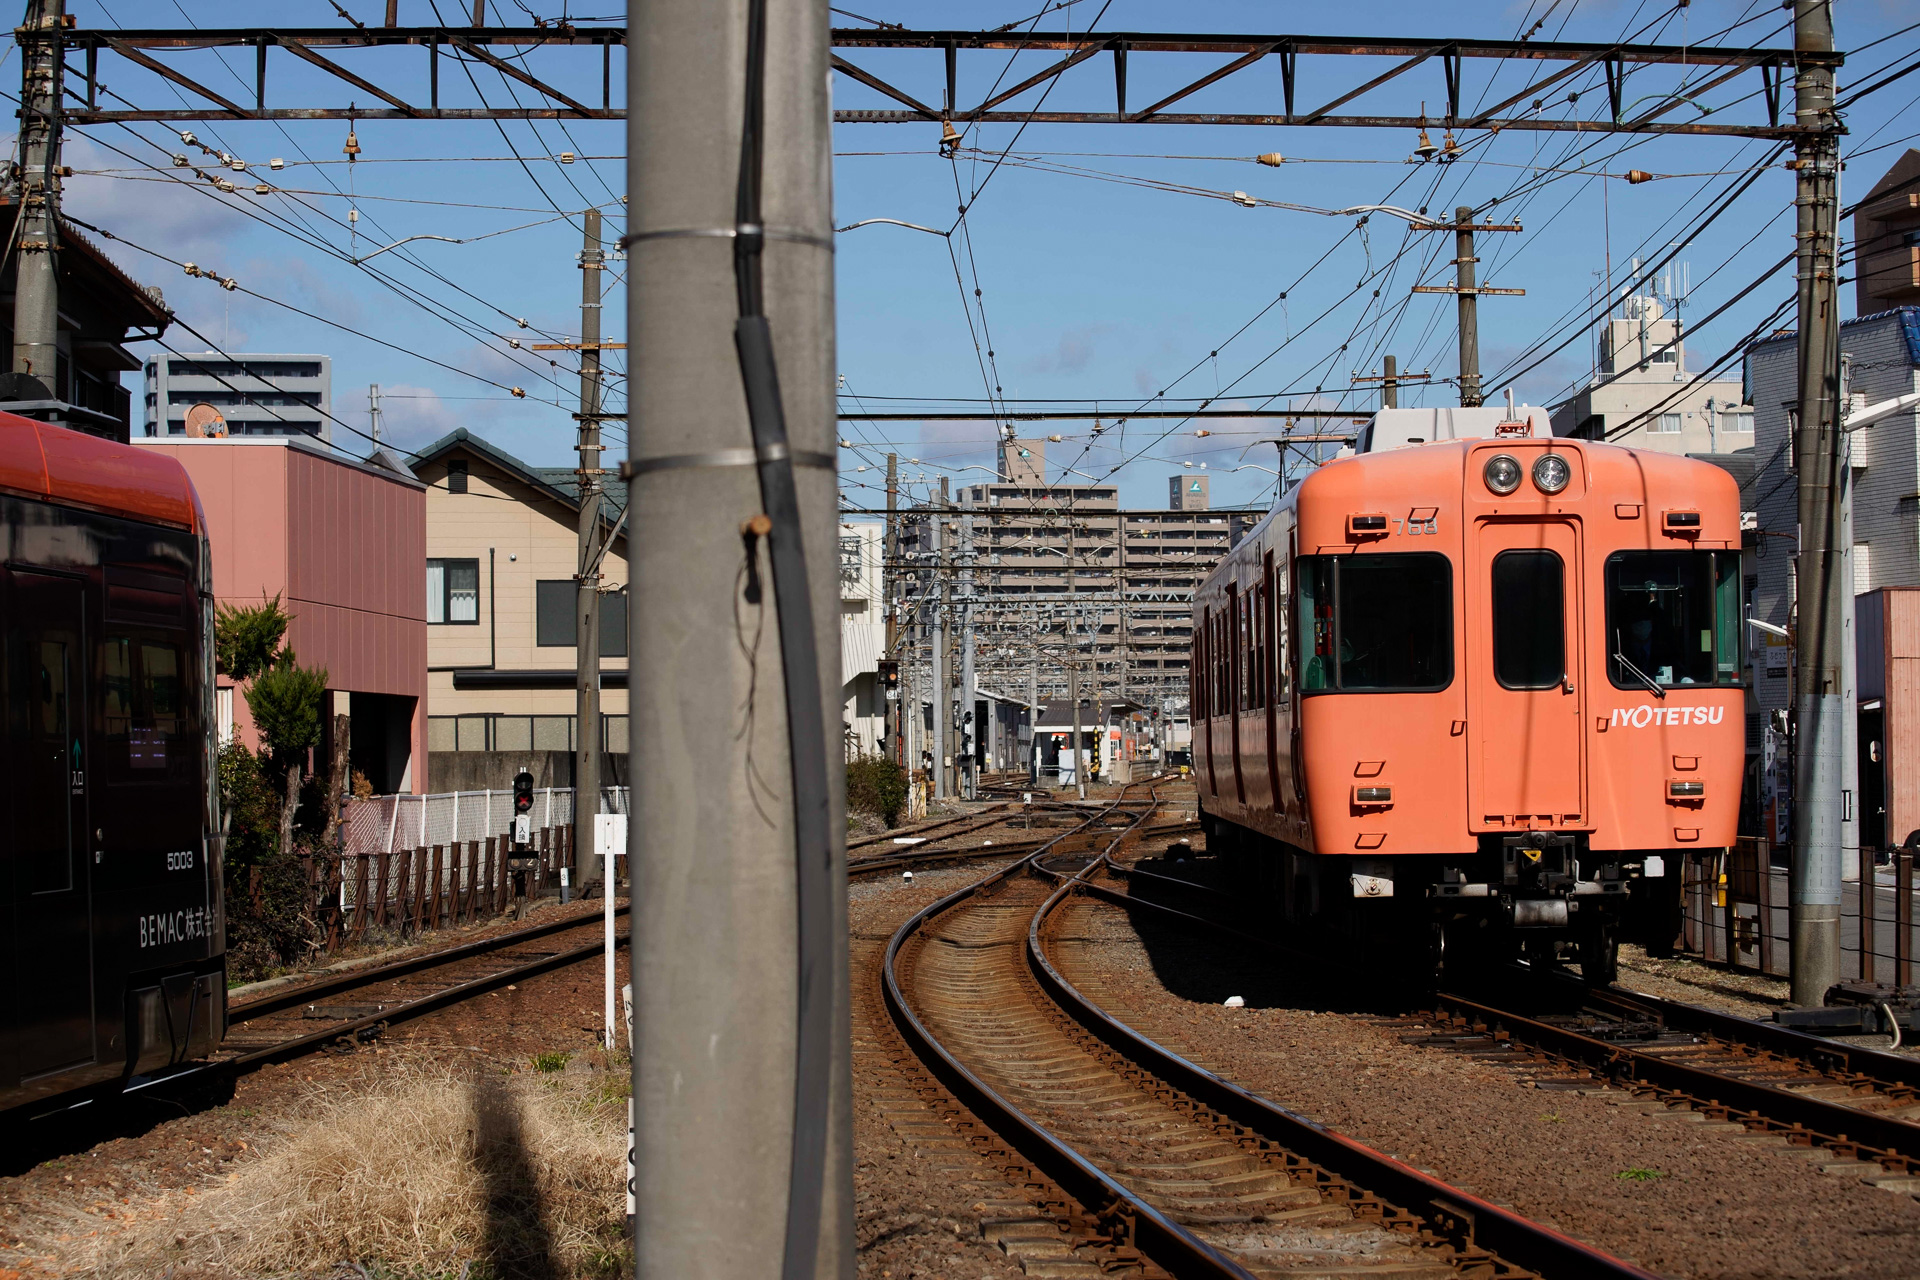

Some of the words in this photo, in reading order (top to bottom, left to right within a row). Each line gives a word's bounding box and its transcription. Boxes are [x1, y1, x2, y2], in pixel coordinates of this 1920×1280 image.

[1392, 516, 1438, 536] 768
[1611, 705, 1724, 728] IYOTETSU
[72, 770, 84, 786] 入口
[167, 850, 193, 871] 5003
[561, 873, 567, 881] 3
